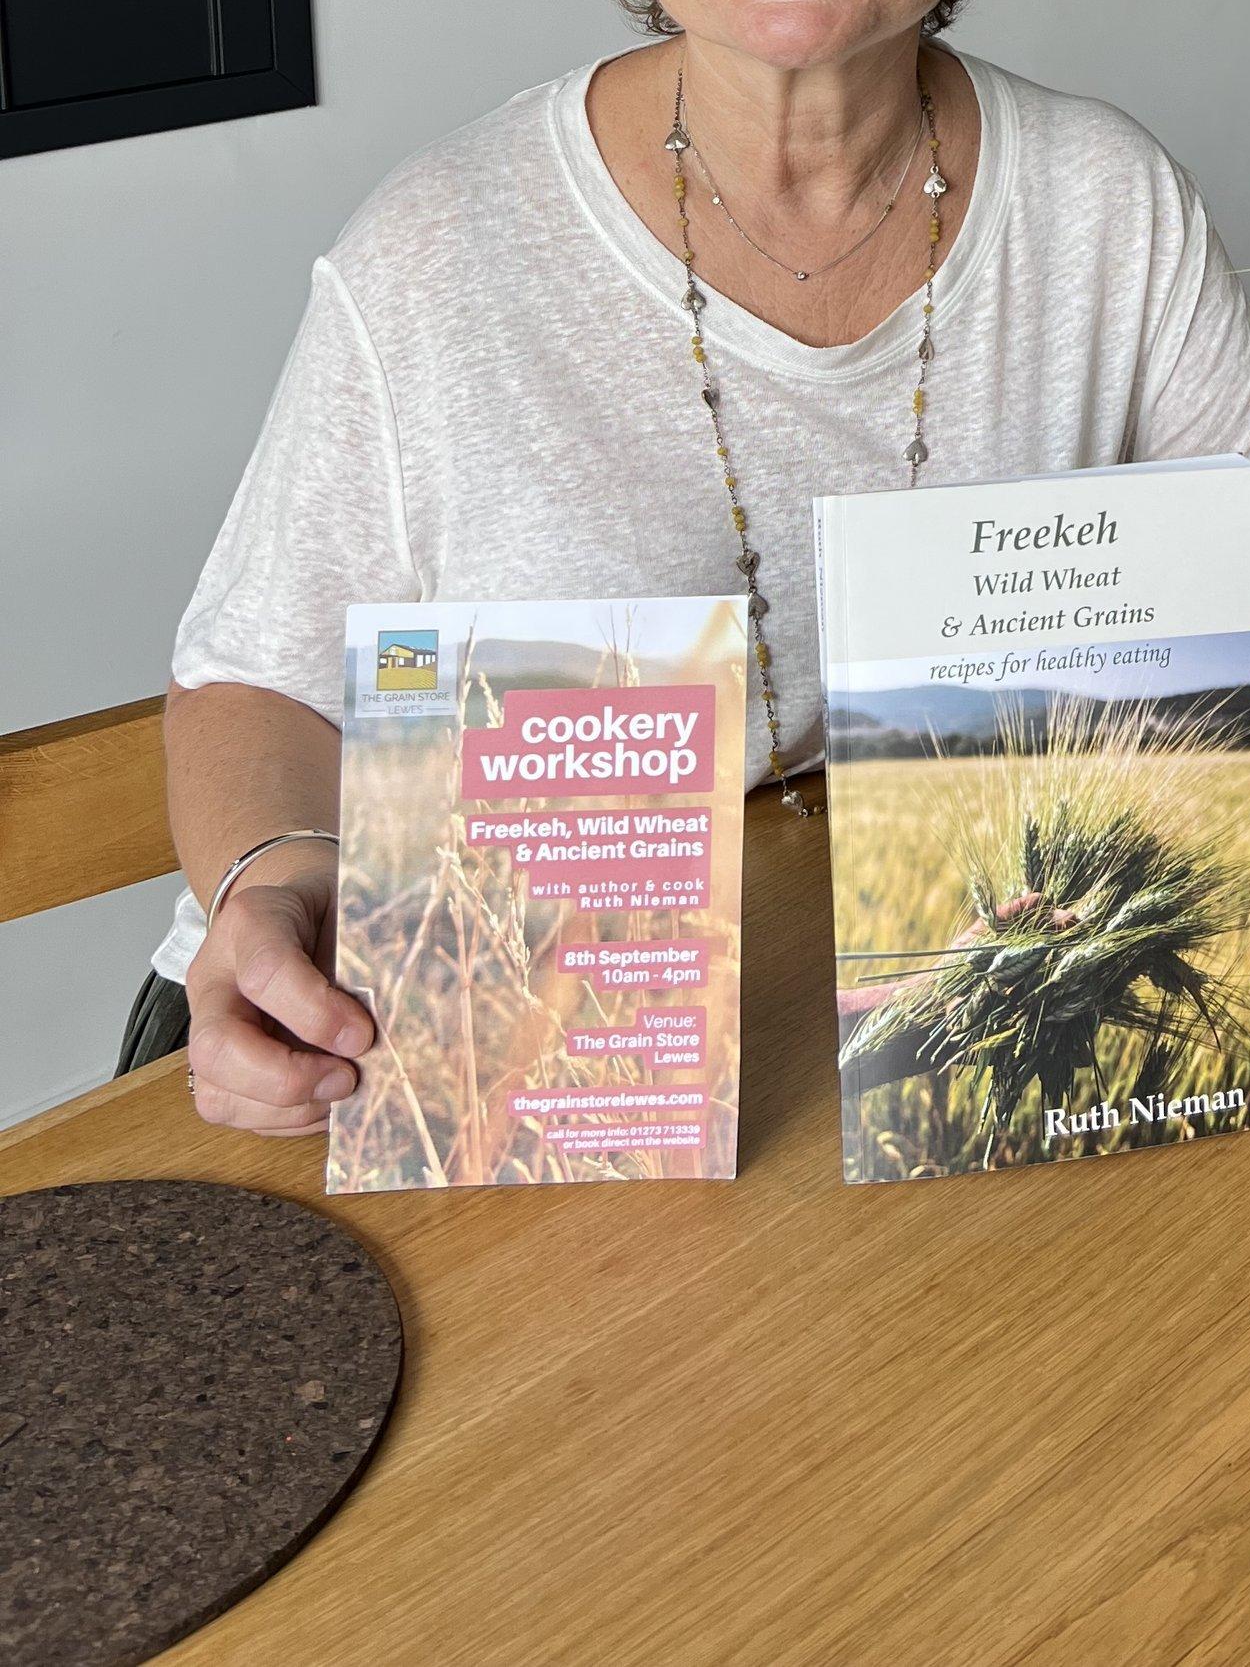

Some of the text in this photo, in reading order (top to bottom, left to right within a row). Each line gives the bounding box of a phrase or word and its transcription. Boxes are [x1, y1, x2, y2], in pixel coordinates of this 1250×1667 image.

[970, 510, 1118, 554] Freekeh
[973, 566, 1122, 596] Wild Wheat
[941, 602, 1155, 638] & Ancient Grains
[929, 643, 1172, 684] recipes for healthy eating
[362, 691, 450, 703] THE GRAIN STORE
[388, 705, 423, 715] LEWES
[521, 706, 699, 748] cookery
[480, 742, 698, 784] workshop
[471, 814, 709, 840] Freekeh, Wild Wheat
[515, 838, 704, 862] & Ancient Grains
[532, 878, 704, 896] with author & cook
[580, 893, 700, 909] Ruth Nieman
[564, 947, 700, 967] 8th September
[602, 969, 650, 984] 10am
[661, 967, 701, 985] 4pm
[643, 1015, 697, 1029] Venue:
[573, 1033, 700, 1050] The Grain Store
[654, 1052, 700, 1064] Lewes
[513, 1092, 703, 1112] thegrainstorelewes.com
[1045, 1087, 1247, 1136] Ruth Nieman
[547, 1129, 564, 1139] call
[566, 1128, 579, 1138] for
[581, 1128, 606, 1138] more
[630, 1124, 661, 1136] 01273
[563, 1134, 700, 1149] or book direct on the website
